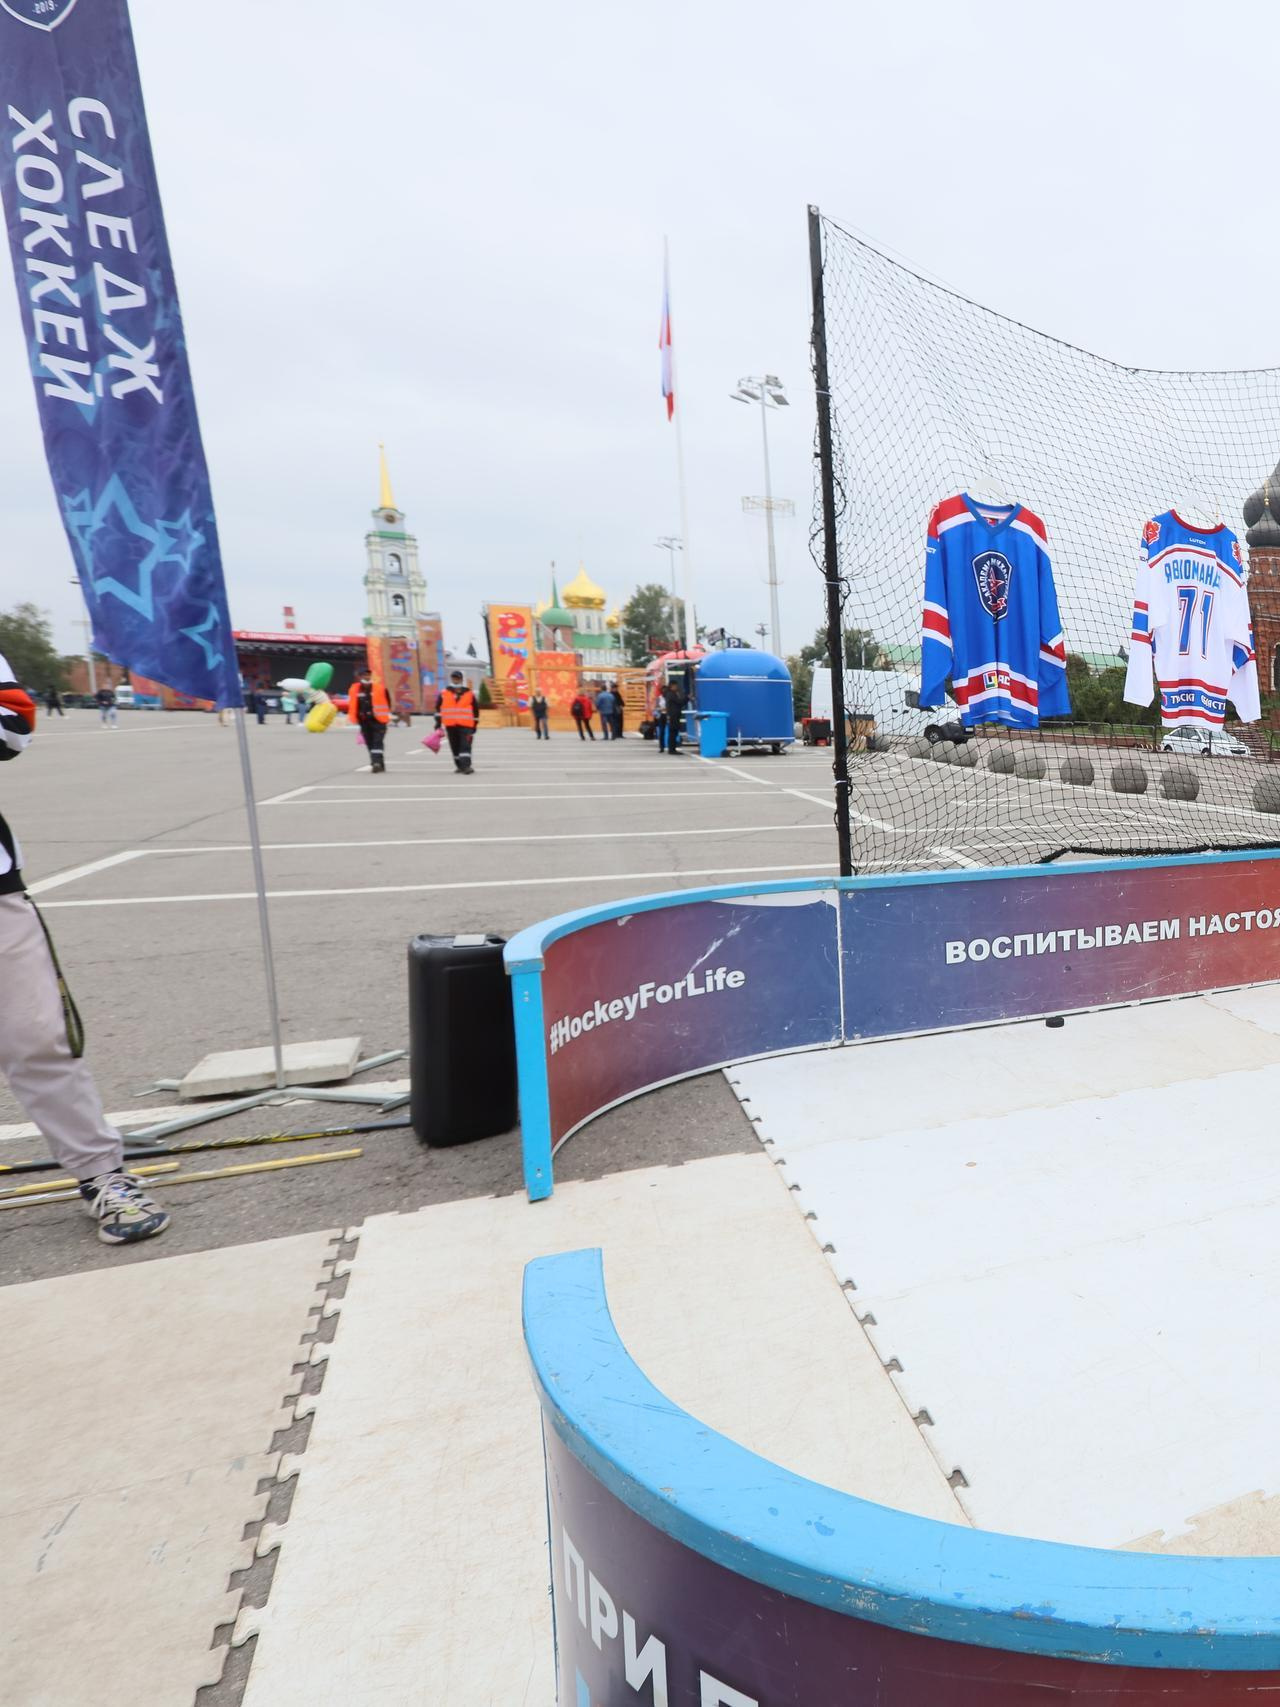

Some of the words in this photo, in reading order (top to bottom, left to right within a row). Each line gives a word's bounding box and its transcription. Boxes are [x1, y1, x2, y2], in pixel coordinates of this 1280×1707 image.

[7, 104, 104, 406] ХОККЕЙ
[67, 96, 164, 405] СЛЕДЖ
[1176, 585, 1214, 660] 71
[945, 919, 1181, 965] ВОСПИТЫВАЕМ
[549, 967, 746, 1055] #HockeyForLife
[562, 1526, 669, 1707] ПРИ
